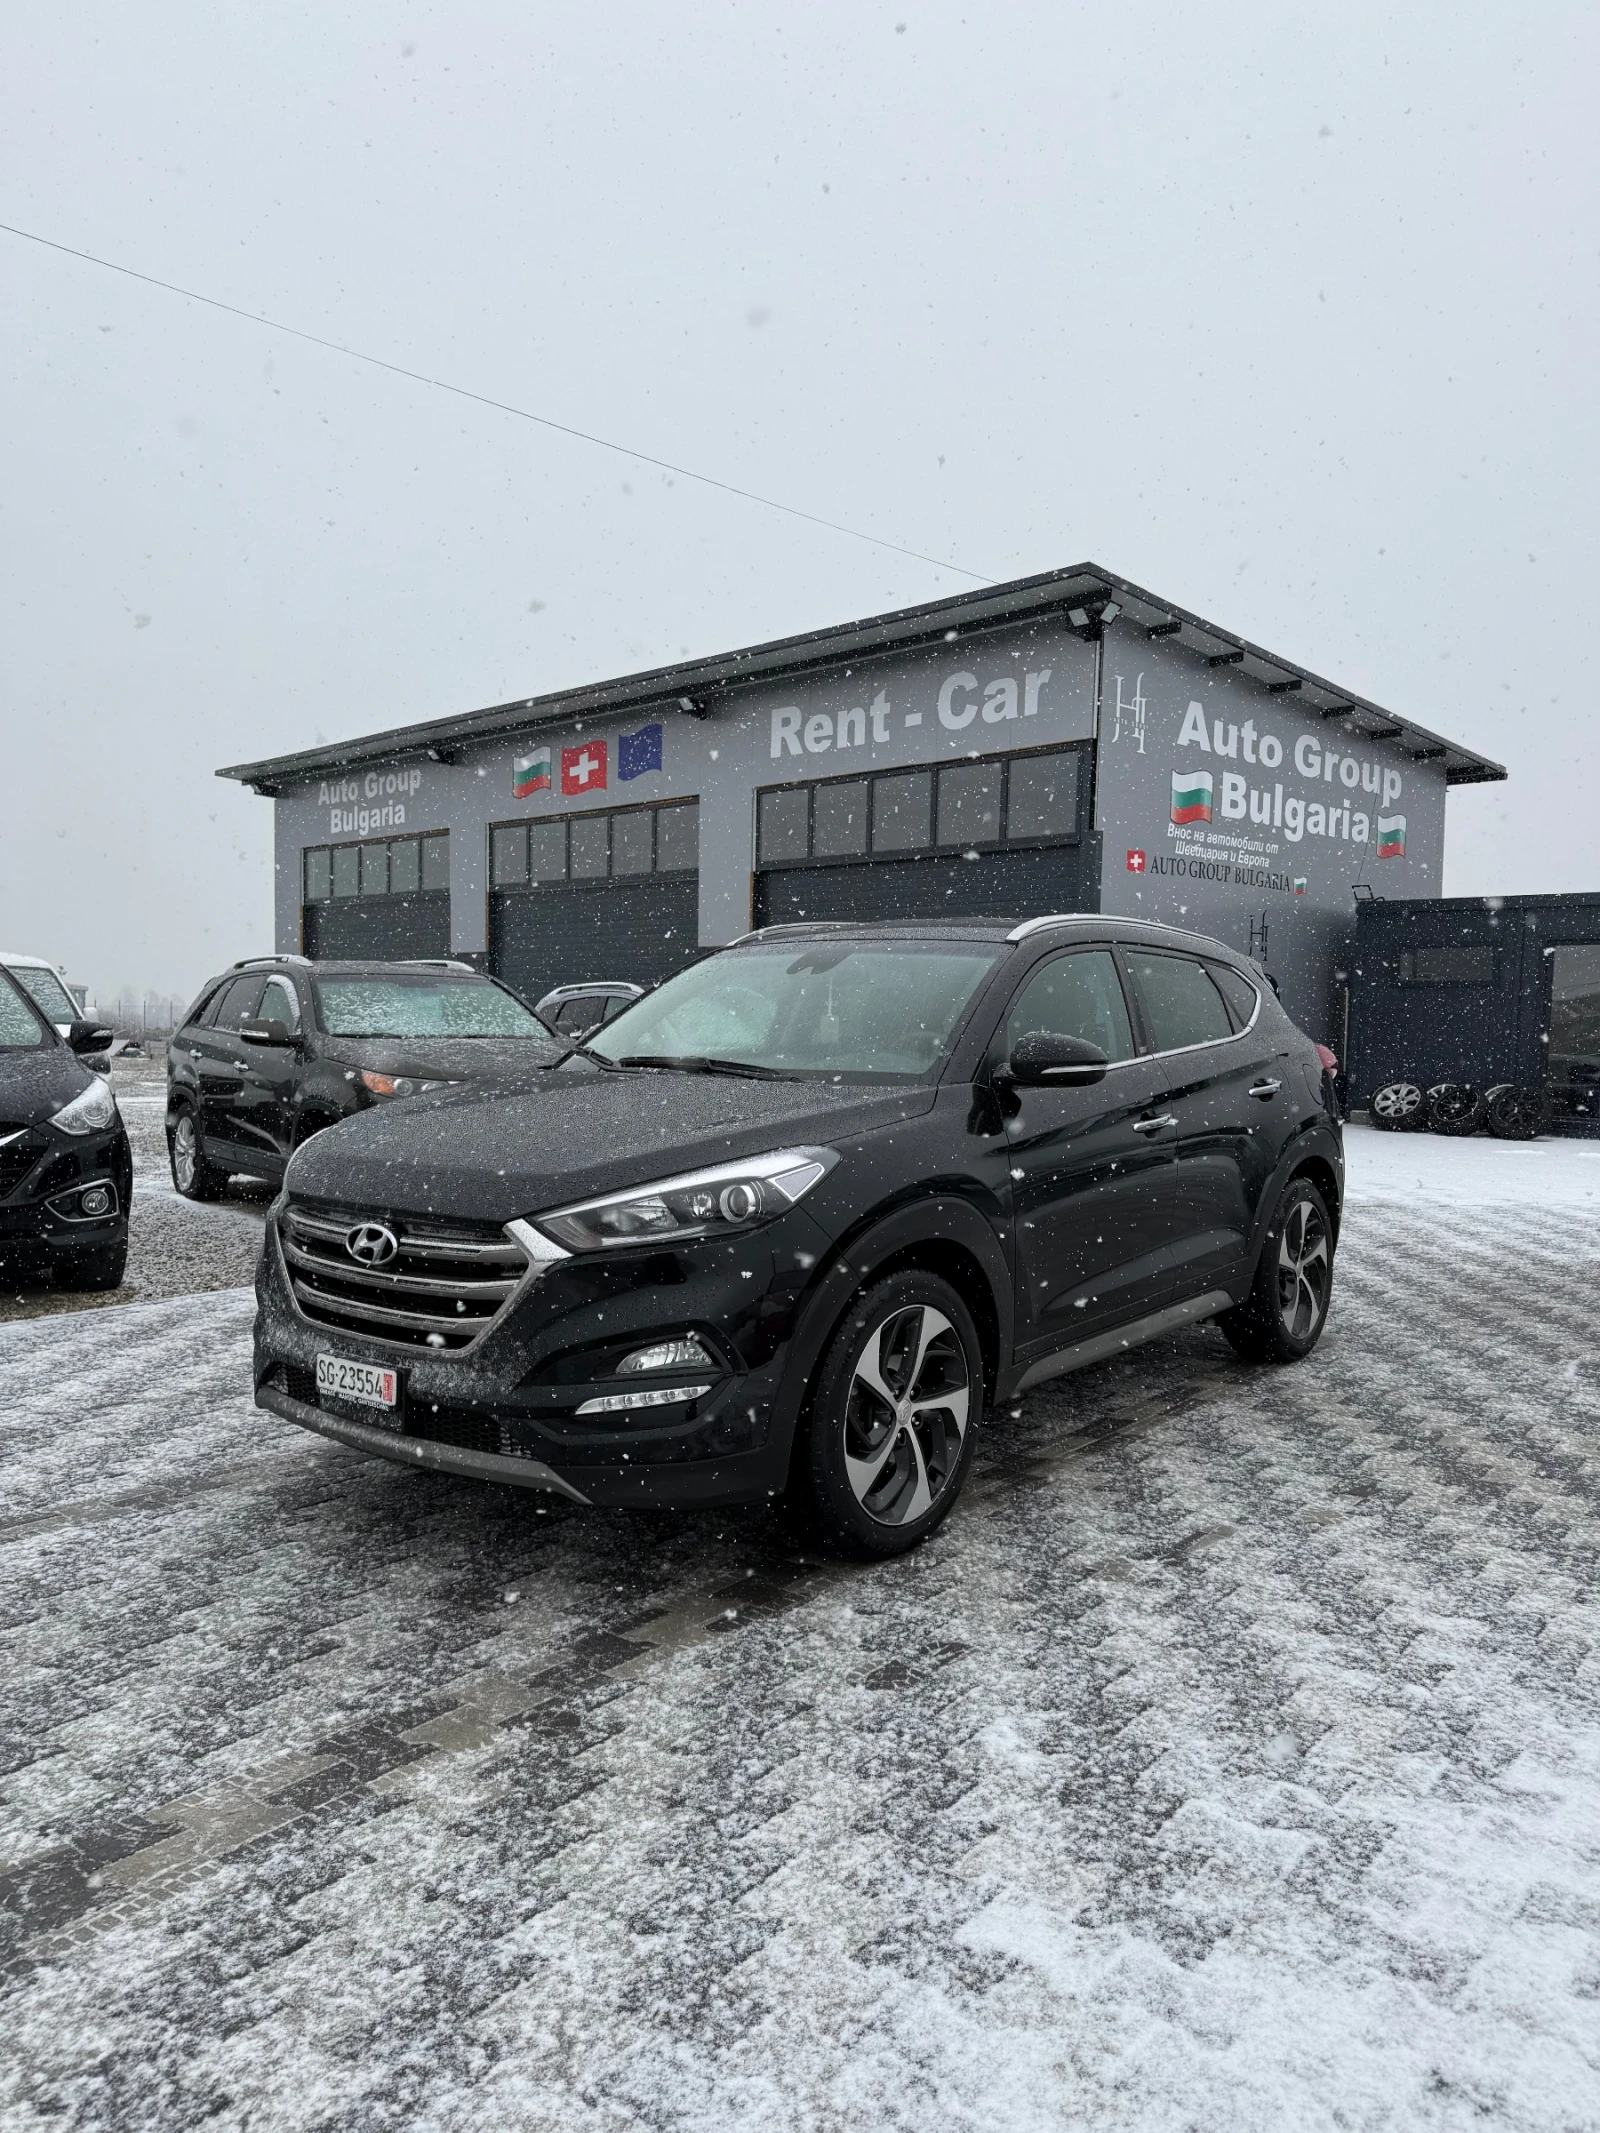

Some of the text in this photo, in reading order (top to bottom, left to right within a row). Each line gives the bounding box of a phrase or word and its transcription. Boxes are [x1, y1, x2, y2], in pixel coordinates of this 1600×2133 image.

[770, 689, 890, 759] Rent
[937, 669, 1052, 730] Car
[1177, 701, 1402, 808] Auto Group
[318, 767, 421, 807] Auto Group
[330, 800, 406, 837] Bulgaria
[1221, 772, 1370, 843] Bulgaria
[1167, 823, 1279, 855] Внос на автомобили от
[1150, 856, 1291, 892] AUTO GROUP BULGARIA
[1238, 850, 1270, 868] Европа
